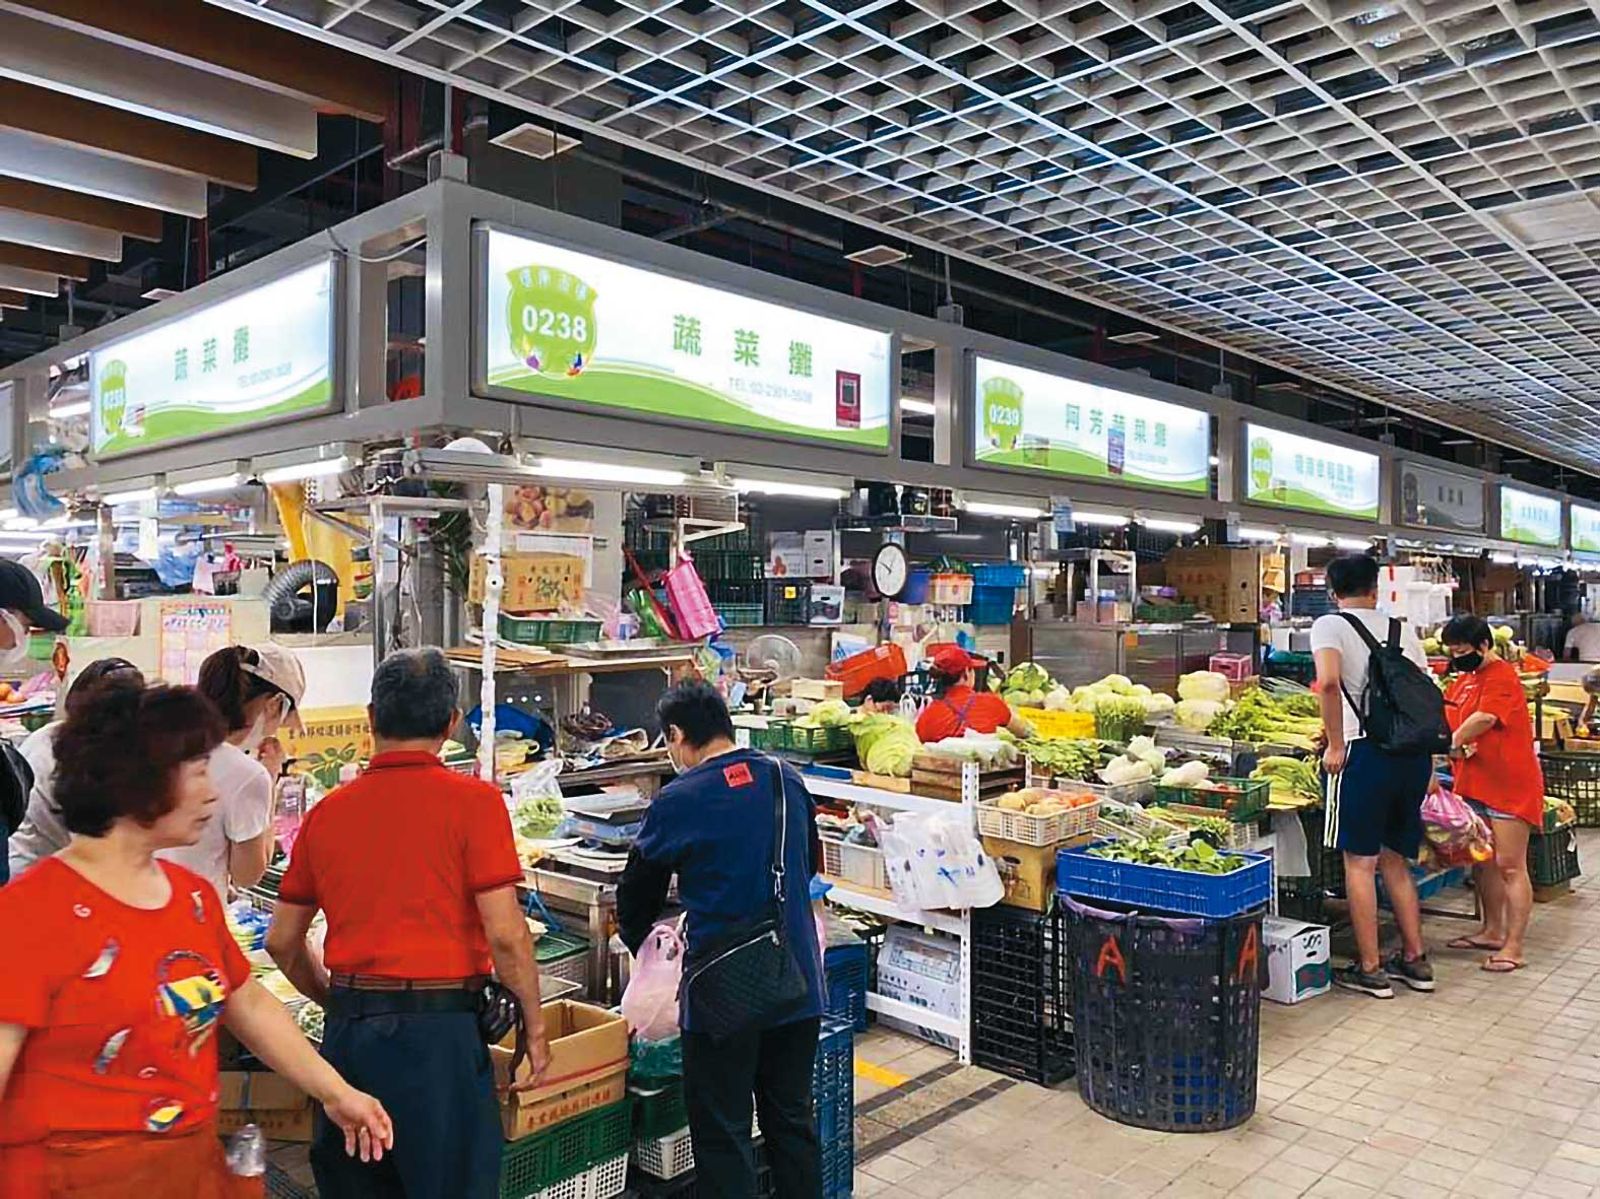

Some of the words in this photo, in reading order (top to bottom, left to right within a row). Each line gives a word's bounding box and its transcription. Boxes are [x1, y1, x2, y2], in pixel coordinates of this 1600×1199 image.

[522, 304, 588, 344] 0238
[672, 314, 813, 378] 蔬菜攤
[1096, 934, 1126, 986] A
[1238, 924, 1259, 985] A
